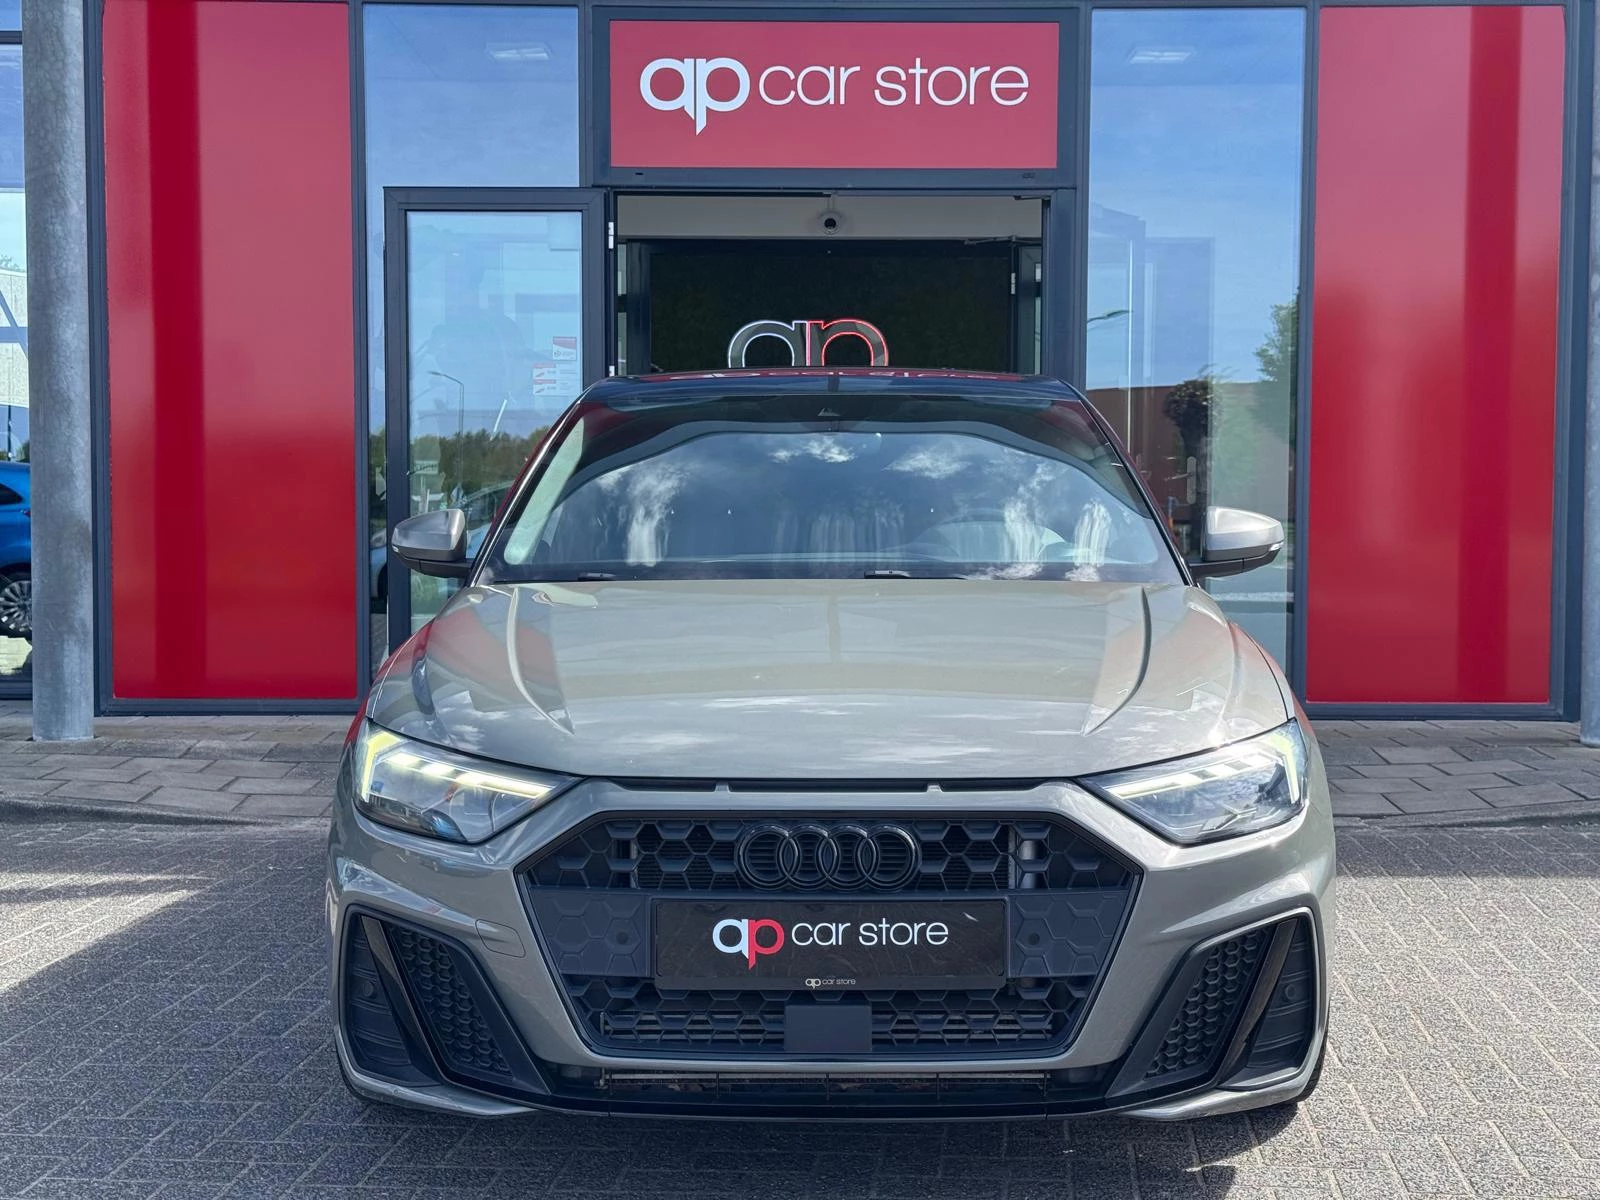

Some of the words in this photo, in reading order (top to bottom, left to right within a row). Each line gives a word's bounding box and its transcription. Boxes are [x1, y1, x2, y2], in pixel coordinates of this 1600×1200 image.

[759, 65, 861, 106] car
[874, 57, 1029, 106] store
[791, 922, 851, 946] car
[858, 917, 949, 946] store
[836, 978, 857, 986] store
